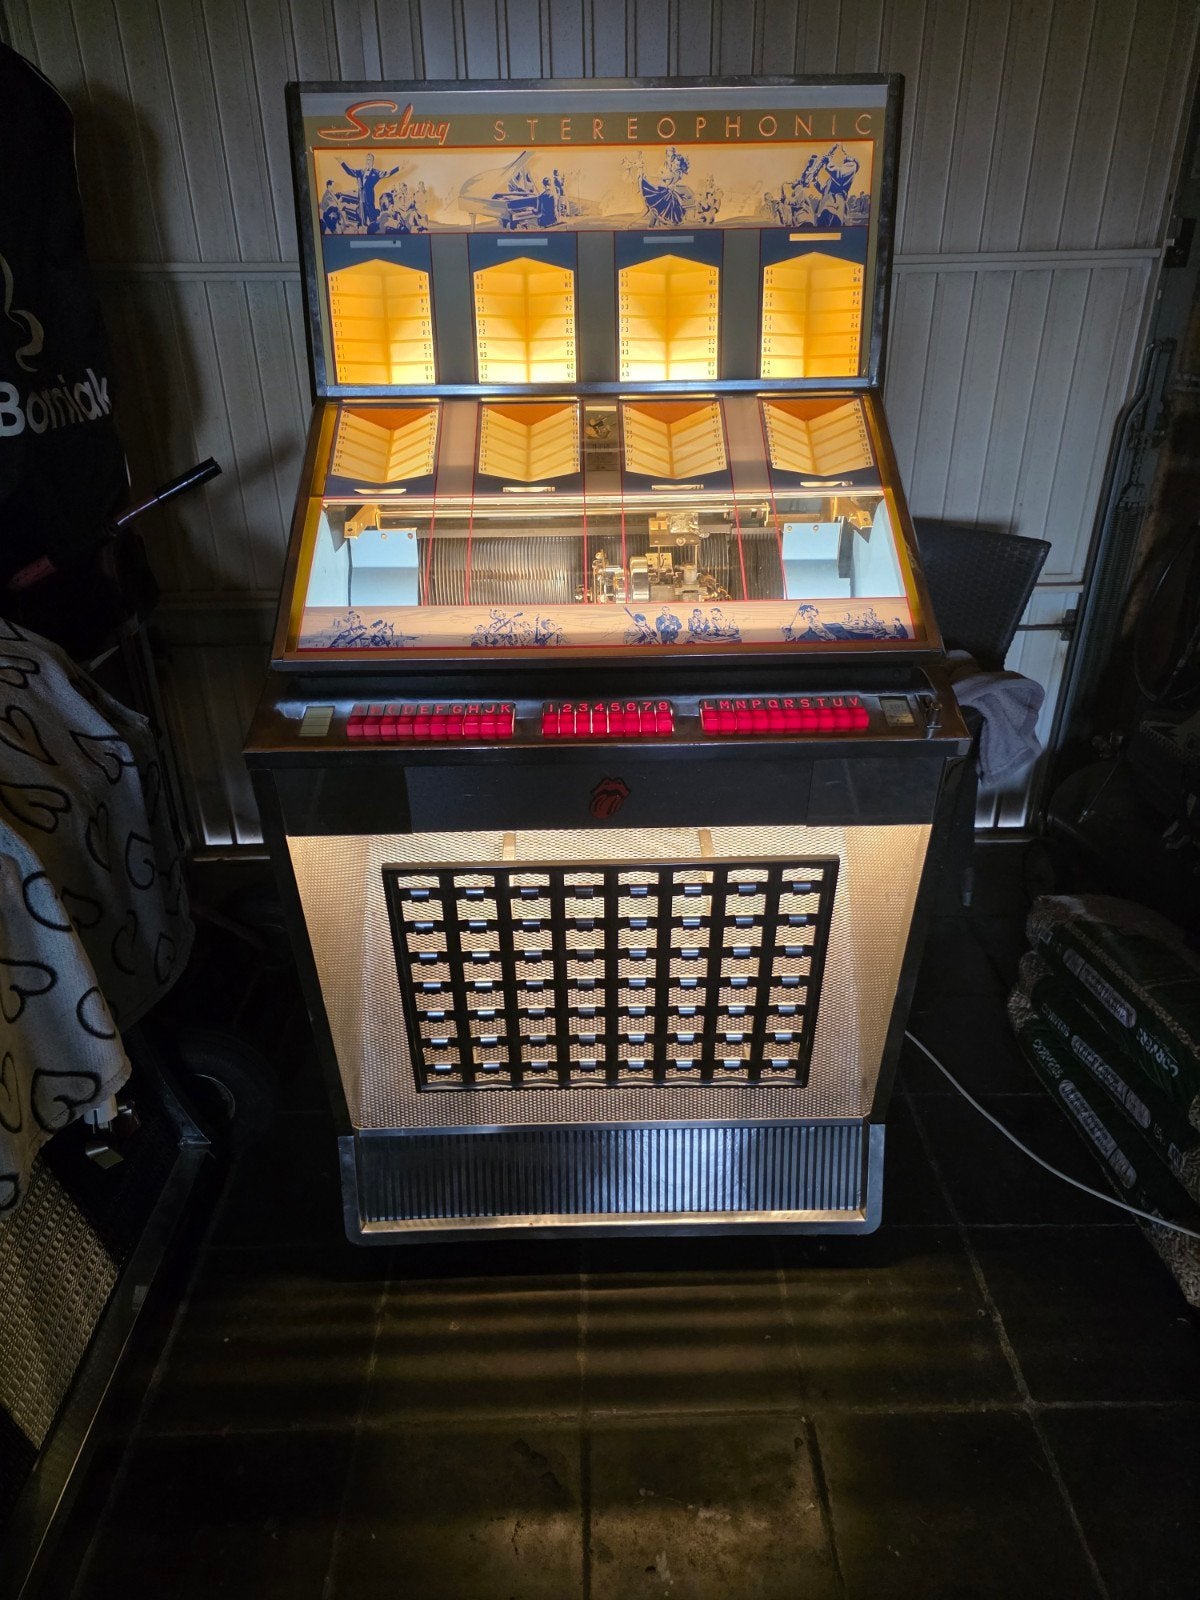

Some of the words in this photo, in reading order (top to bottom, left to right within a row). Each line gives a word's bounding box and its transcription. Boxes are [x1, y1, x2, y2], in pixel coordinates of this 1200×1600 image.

[317, 99, 451, 145] Seeburg
[493, 113, 873, 142] STEREOPHONIC
[549, 704, 553, 712] 1
[563, 704, 572, 712] 2
[579, 703, 588, 712] 3
[595, 703, 604, 711] 4
[611, 703, 620, 711] 5
[627, 702, 636, 711] 6
[643, 702, 651, 710] 7
[659, 702, 668, 710] 8
[704, 701, 714, 709] L
[720, 701, 730, 709] M
[737, 700, 746, 708] N
[752, 700, 761, 708] P
[768, 700, 778, 709] Q
[785, 699, 794, 707] R
[802, 699, 810, 707] S
[817, 699, 826, 707] T
[833, 698, 843, 707] U
[849, 698, 859, 706] V
[388, 705, 395, 714] C
[404, 705, 413, 714] D
[420, 704, 429, 713] E
[436, 704, 444, 713] F
[453, 704, 462, 713] G
[469, 704, 479, 713] H
[485, 704, 495, 713] J
[501, 704, 510, 713] K
